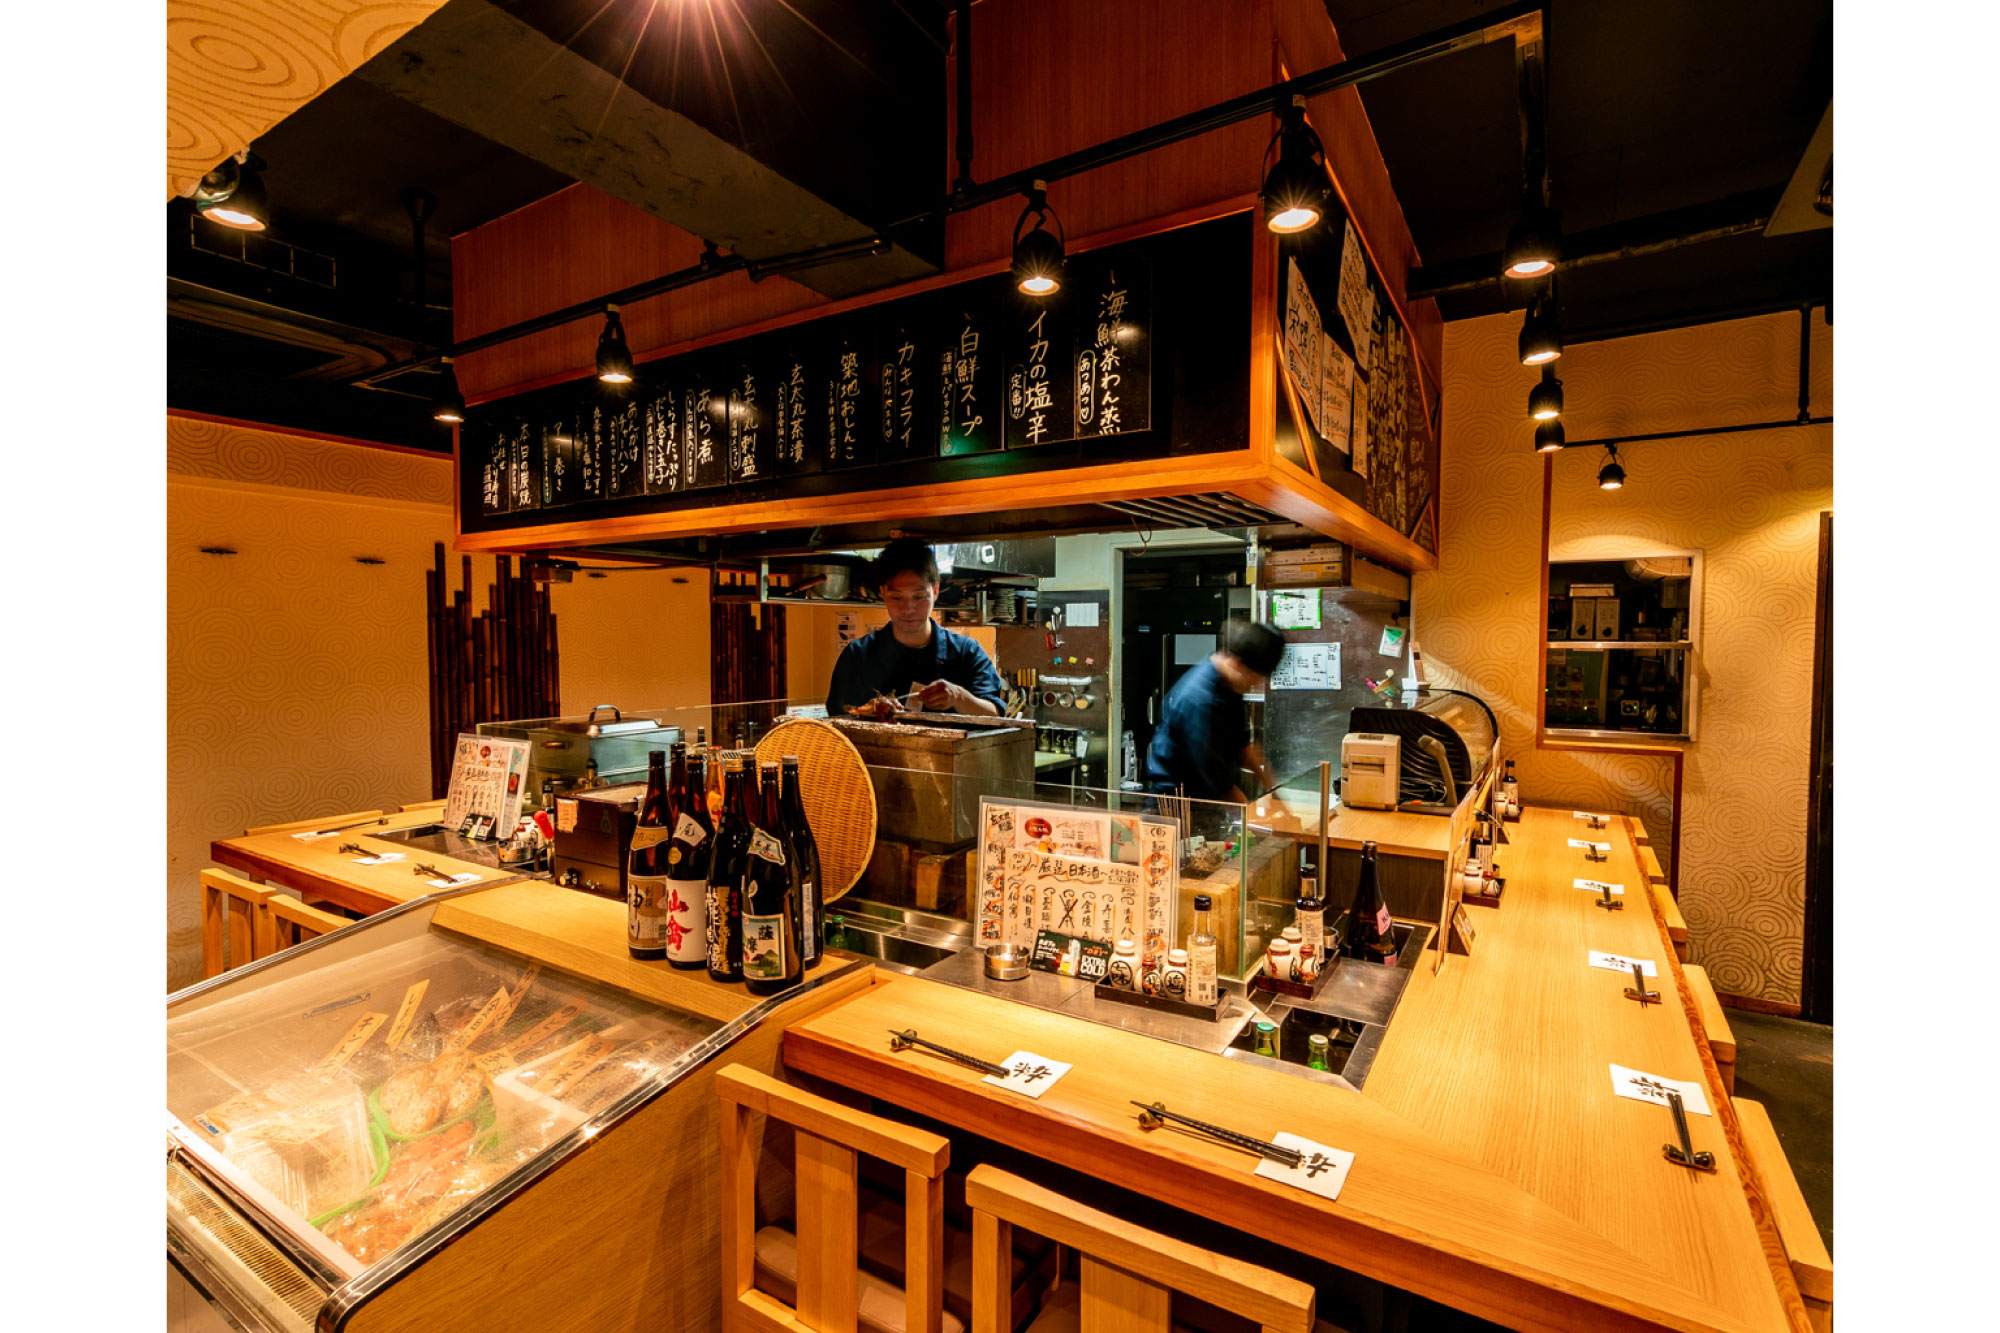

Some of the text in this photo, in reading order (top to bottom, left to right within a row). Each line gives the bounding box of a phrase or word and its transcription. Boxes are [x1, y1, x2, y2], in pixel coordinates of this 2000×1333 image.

[841, 352, 860, 460] 築地おしんこ
[898, 341, 914, 447] カキフライ
[1025, 310, 1053, 443] イカの塩辛
[697, 388, 713, 464] あら煮
[1080, 961, 1105, 976] COLD
[1081, 954, 1106, 967] EXTRA
